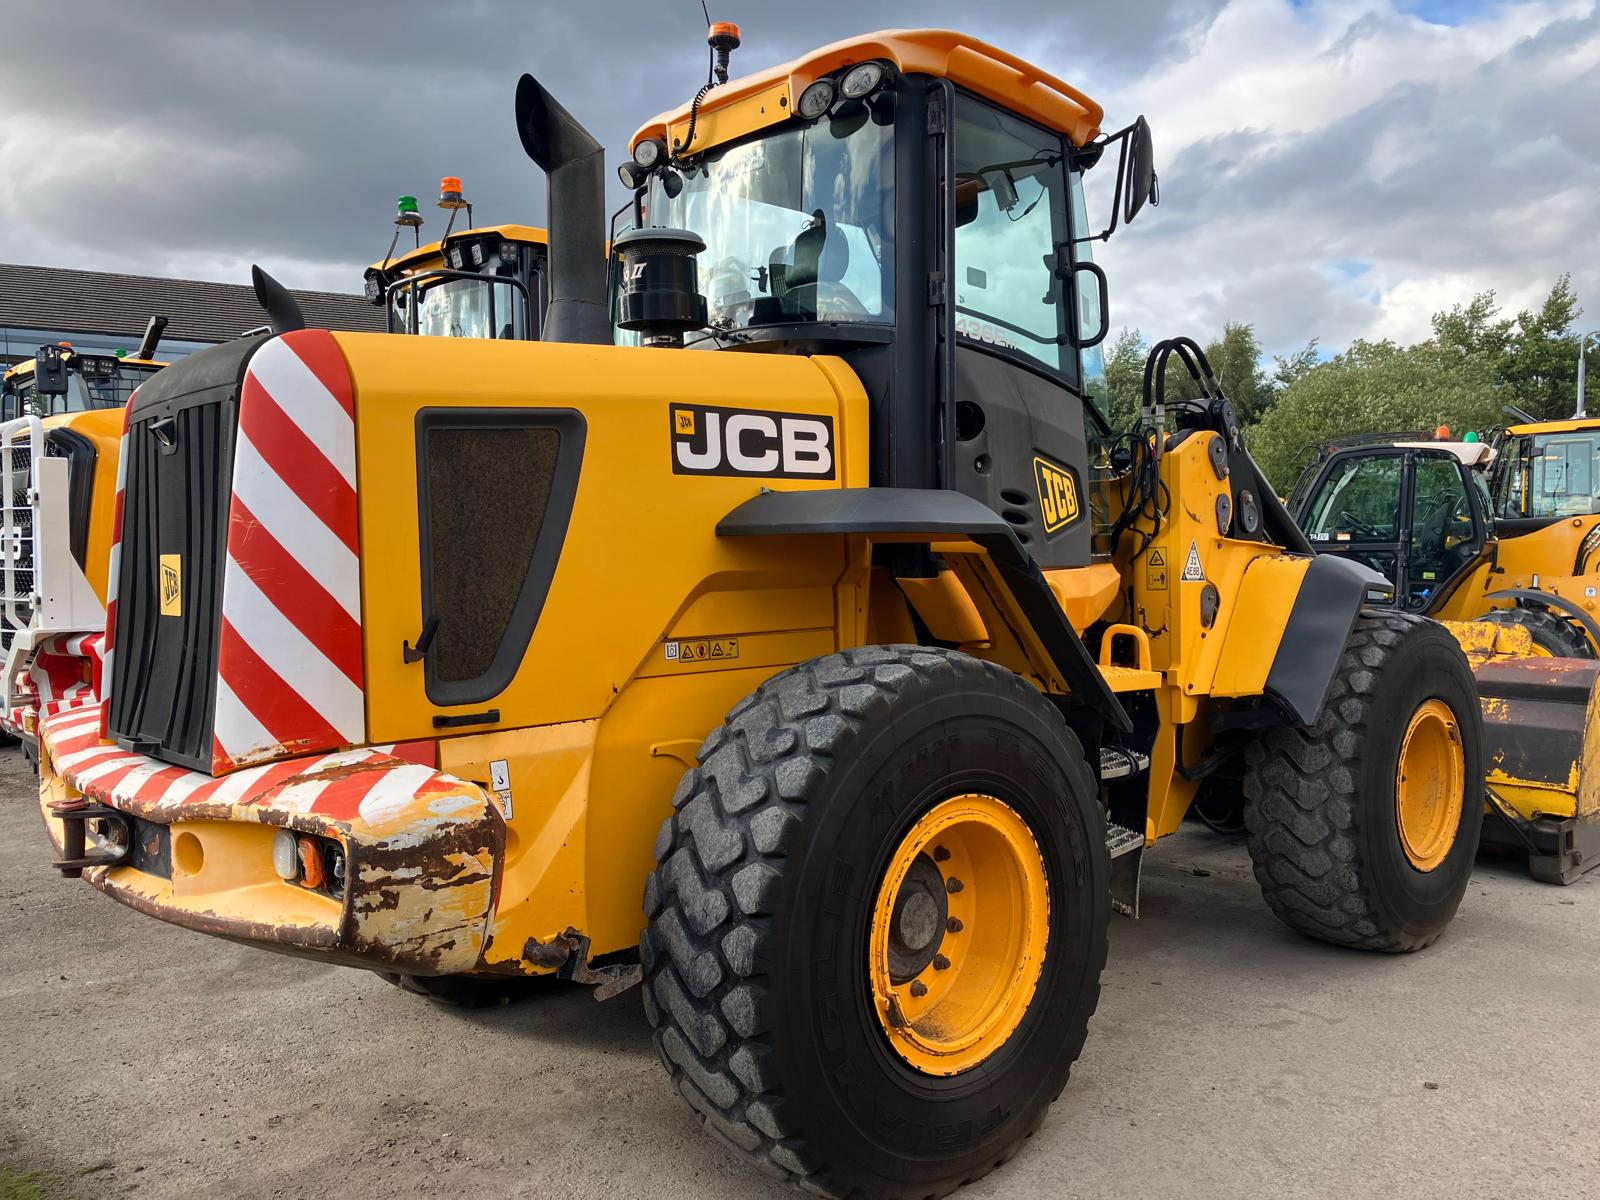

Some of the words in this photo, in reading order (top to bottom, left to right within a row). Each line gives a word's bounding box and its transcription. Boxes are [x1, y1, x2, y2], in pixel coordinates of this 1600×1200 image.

[676, 412, 831, 473] JCB
[680, 415, 692, 428] JCB
[1041, 466, 1076, 524] JCB
[164, 568, 179, 602] JCB
